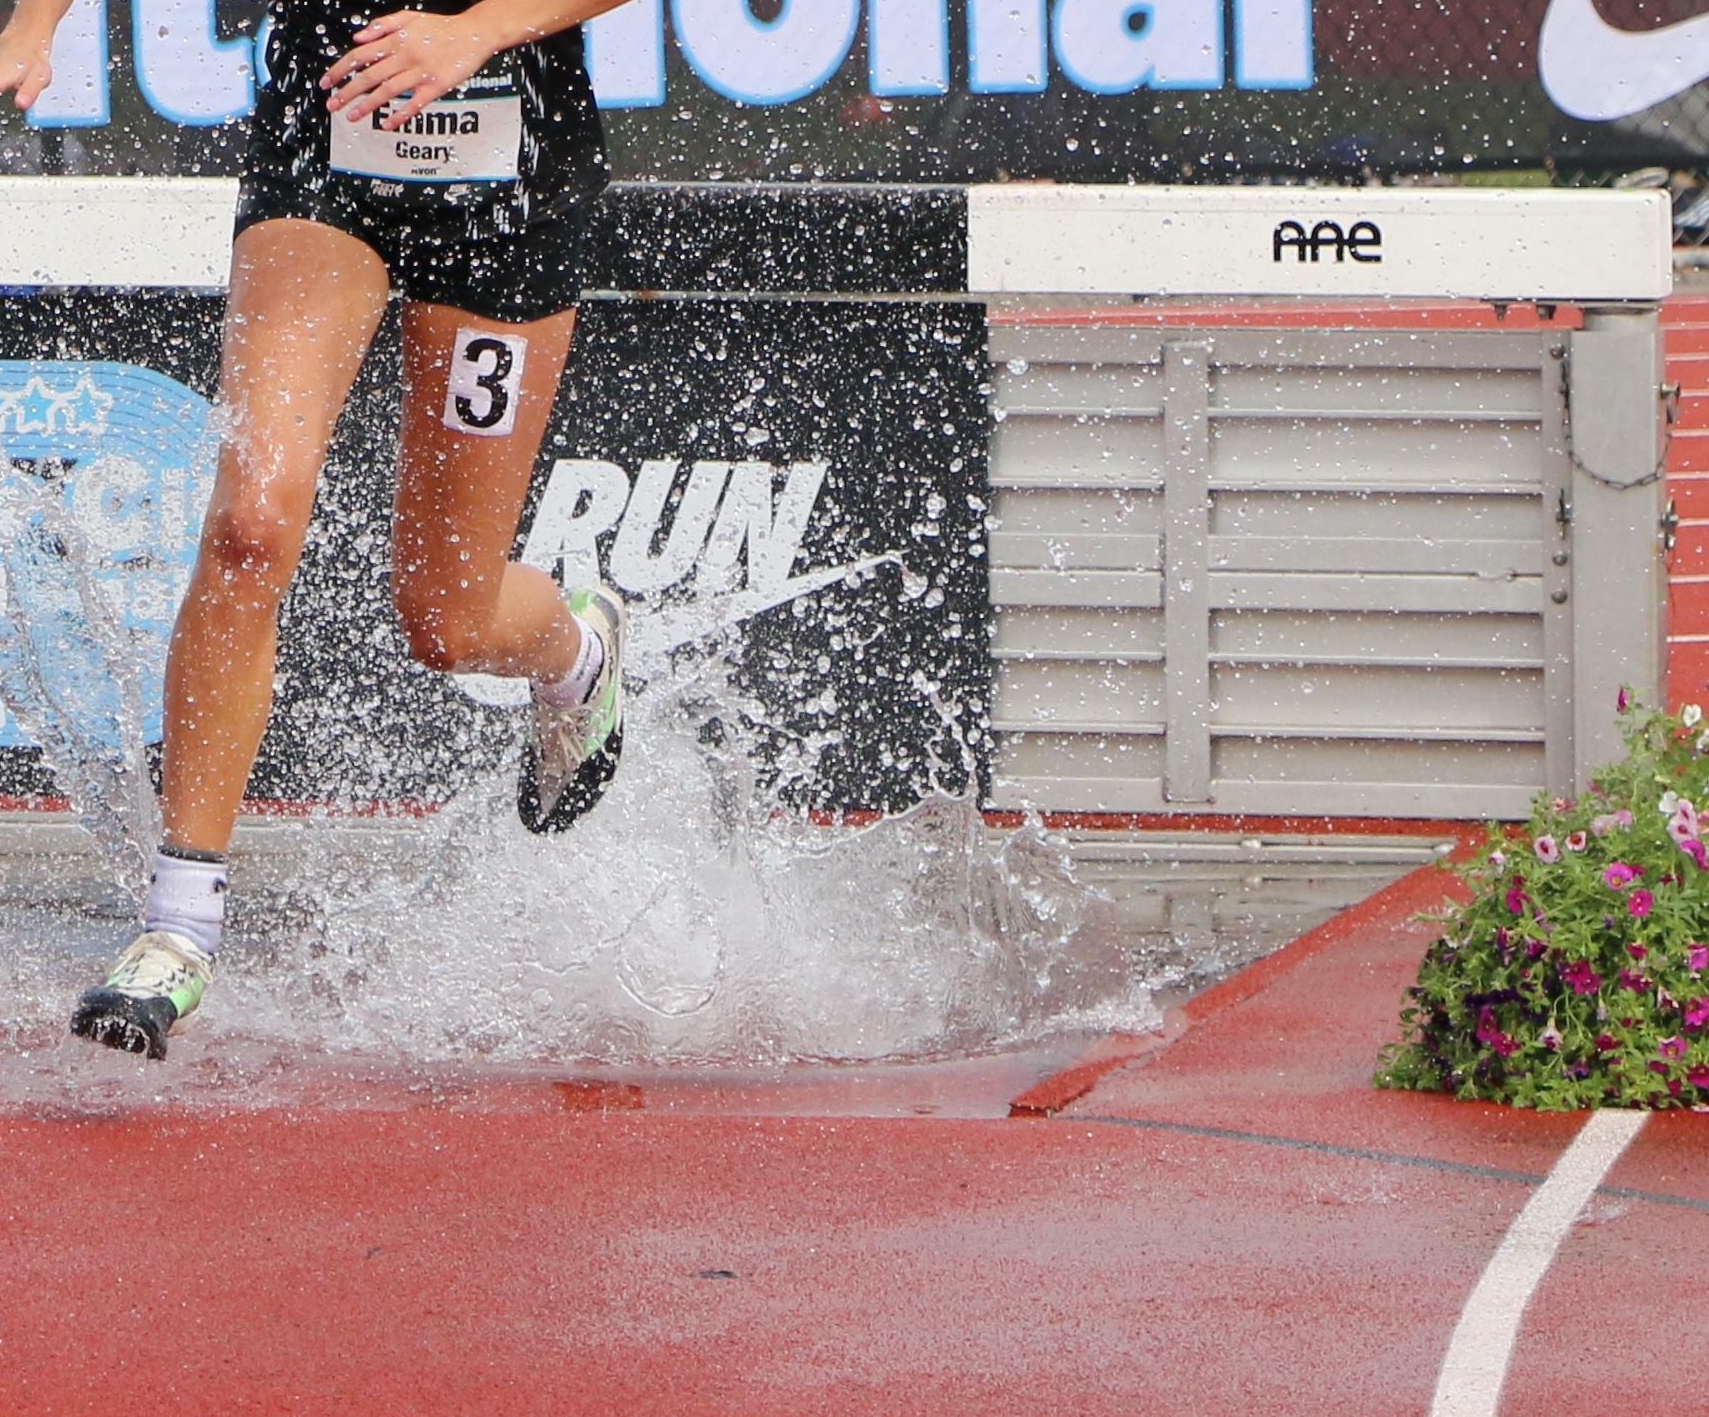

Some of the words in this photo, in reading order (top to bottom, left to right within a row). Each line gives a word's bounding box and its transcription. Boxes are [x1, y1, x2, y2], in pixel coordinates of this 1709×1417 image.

[395, 141, 455, 163] Geary
[454, 337, 513, 429] 3
[520, 458, 830, 596] RUN
